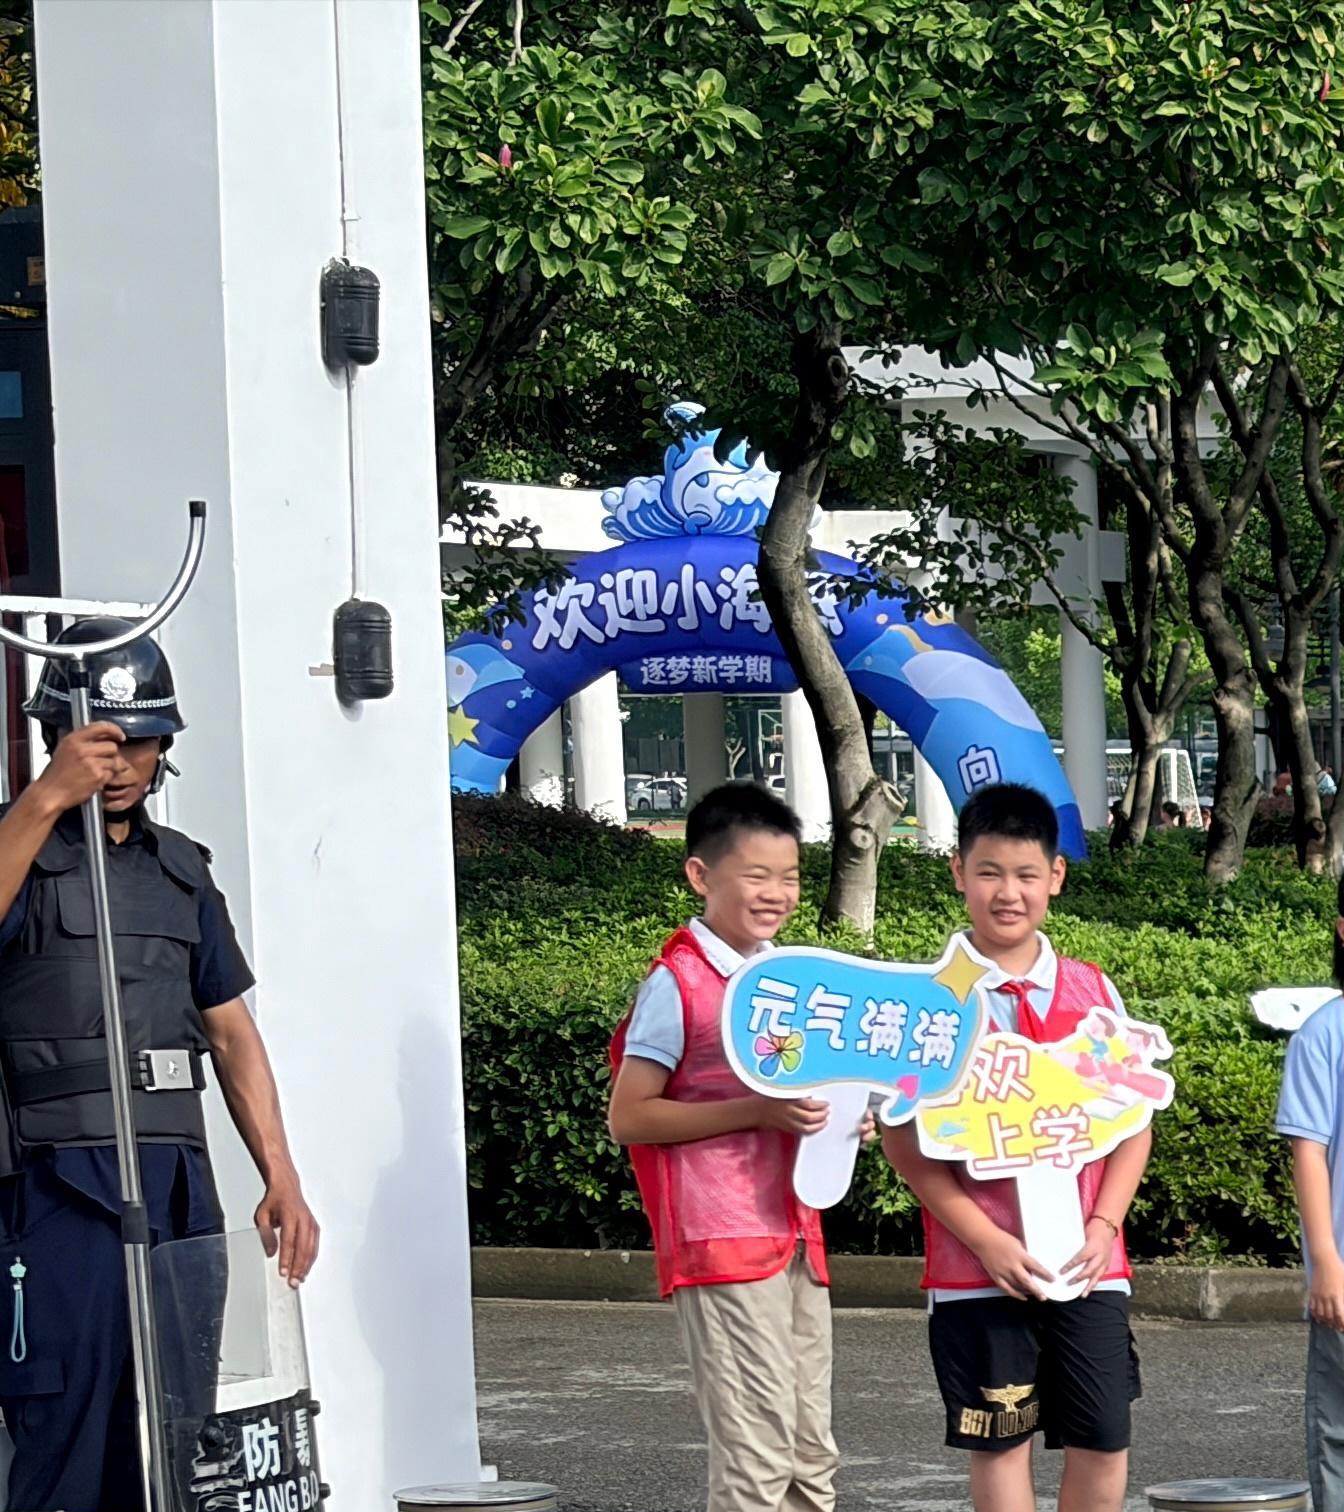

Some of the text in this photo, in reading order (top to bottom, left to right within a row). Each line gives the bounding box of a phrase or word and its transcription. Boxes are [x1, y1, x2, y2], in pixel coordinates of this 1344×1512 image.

[532, 562, 844, 650] 欢迎小海
[640, 655, 773, 686] 逐梦新学期
[748, 975, 962, 1070] 元气满满
[973, 1102, 1094, 1171] 上学
[960, 1407, 993, 1438] BOY
